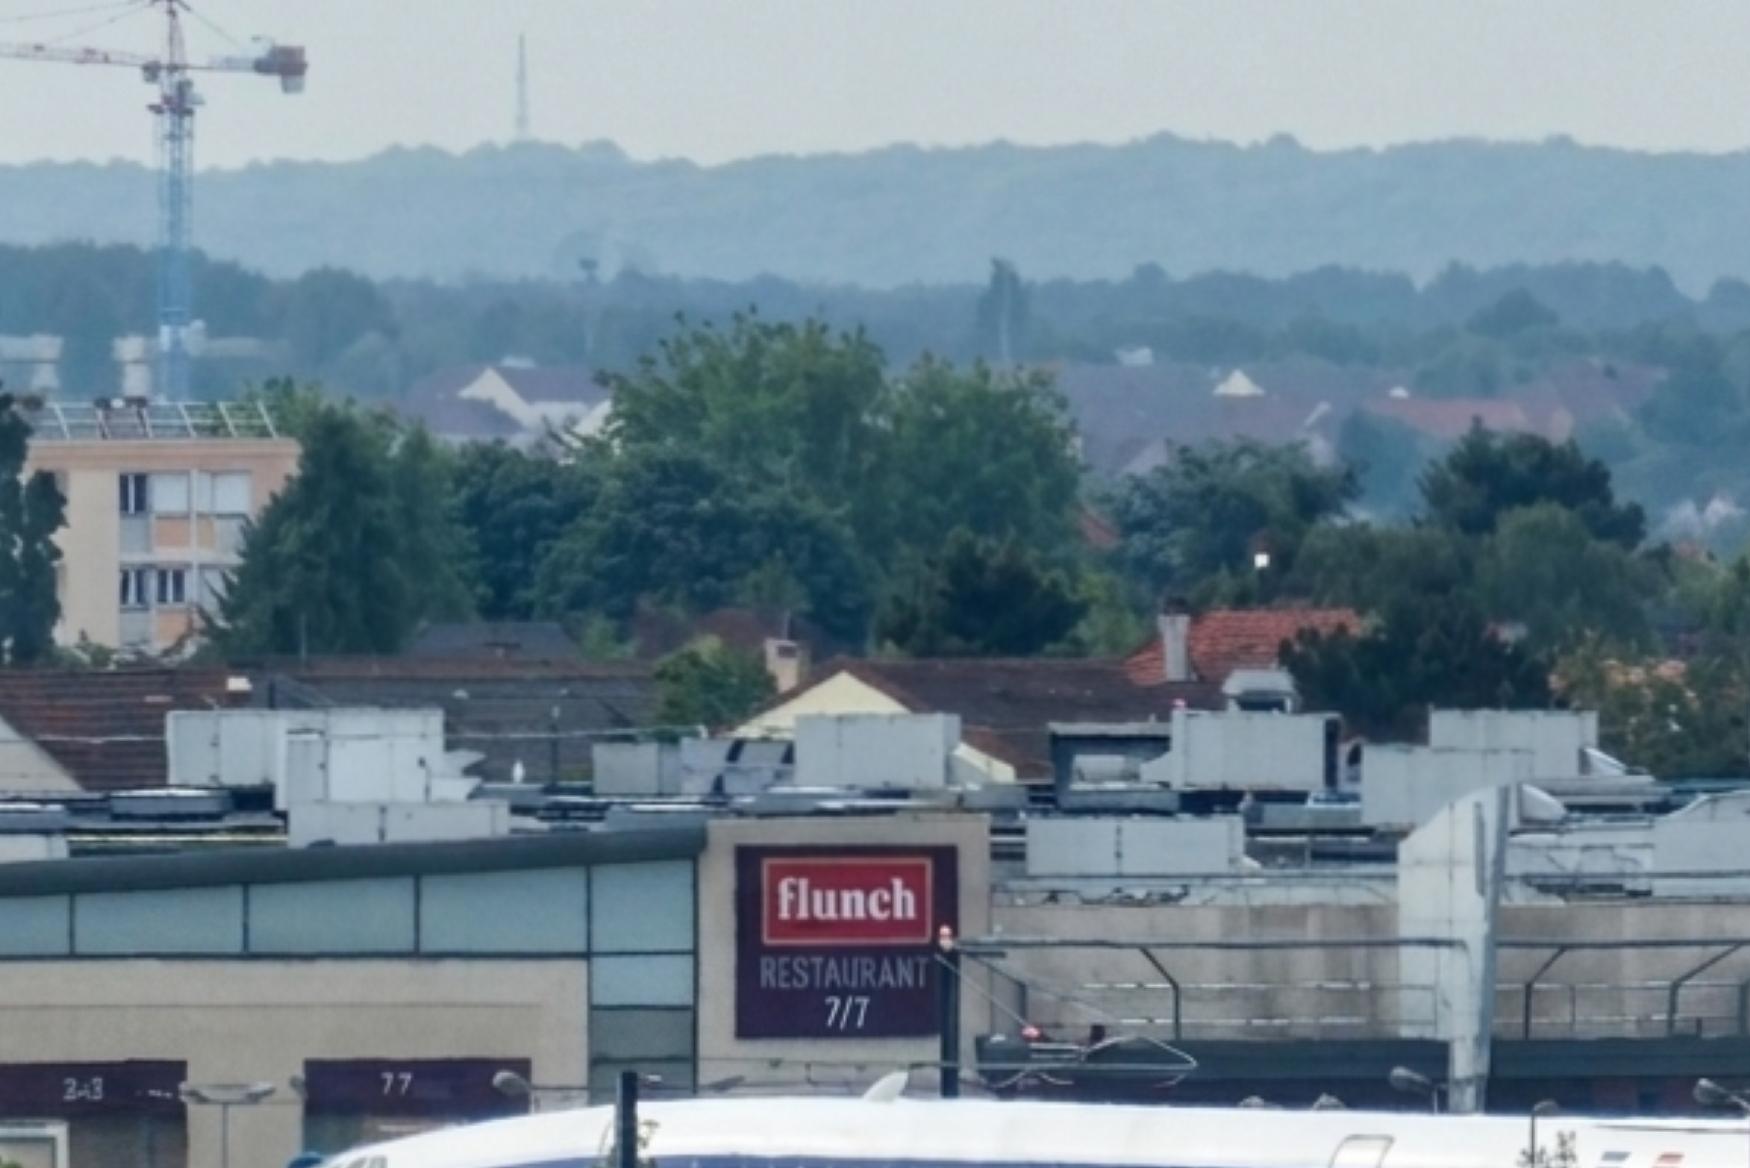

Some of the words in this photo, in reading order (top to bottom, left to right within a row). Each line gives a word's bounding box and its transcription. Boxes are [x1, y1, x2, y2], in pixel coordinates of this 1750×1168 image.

[777, 876, 917, 921] flunch
[759, 956, 929, 989] RESTAURANT
[824, 995, 871, 1030] 7/7
